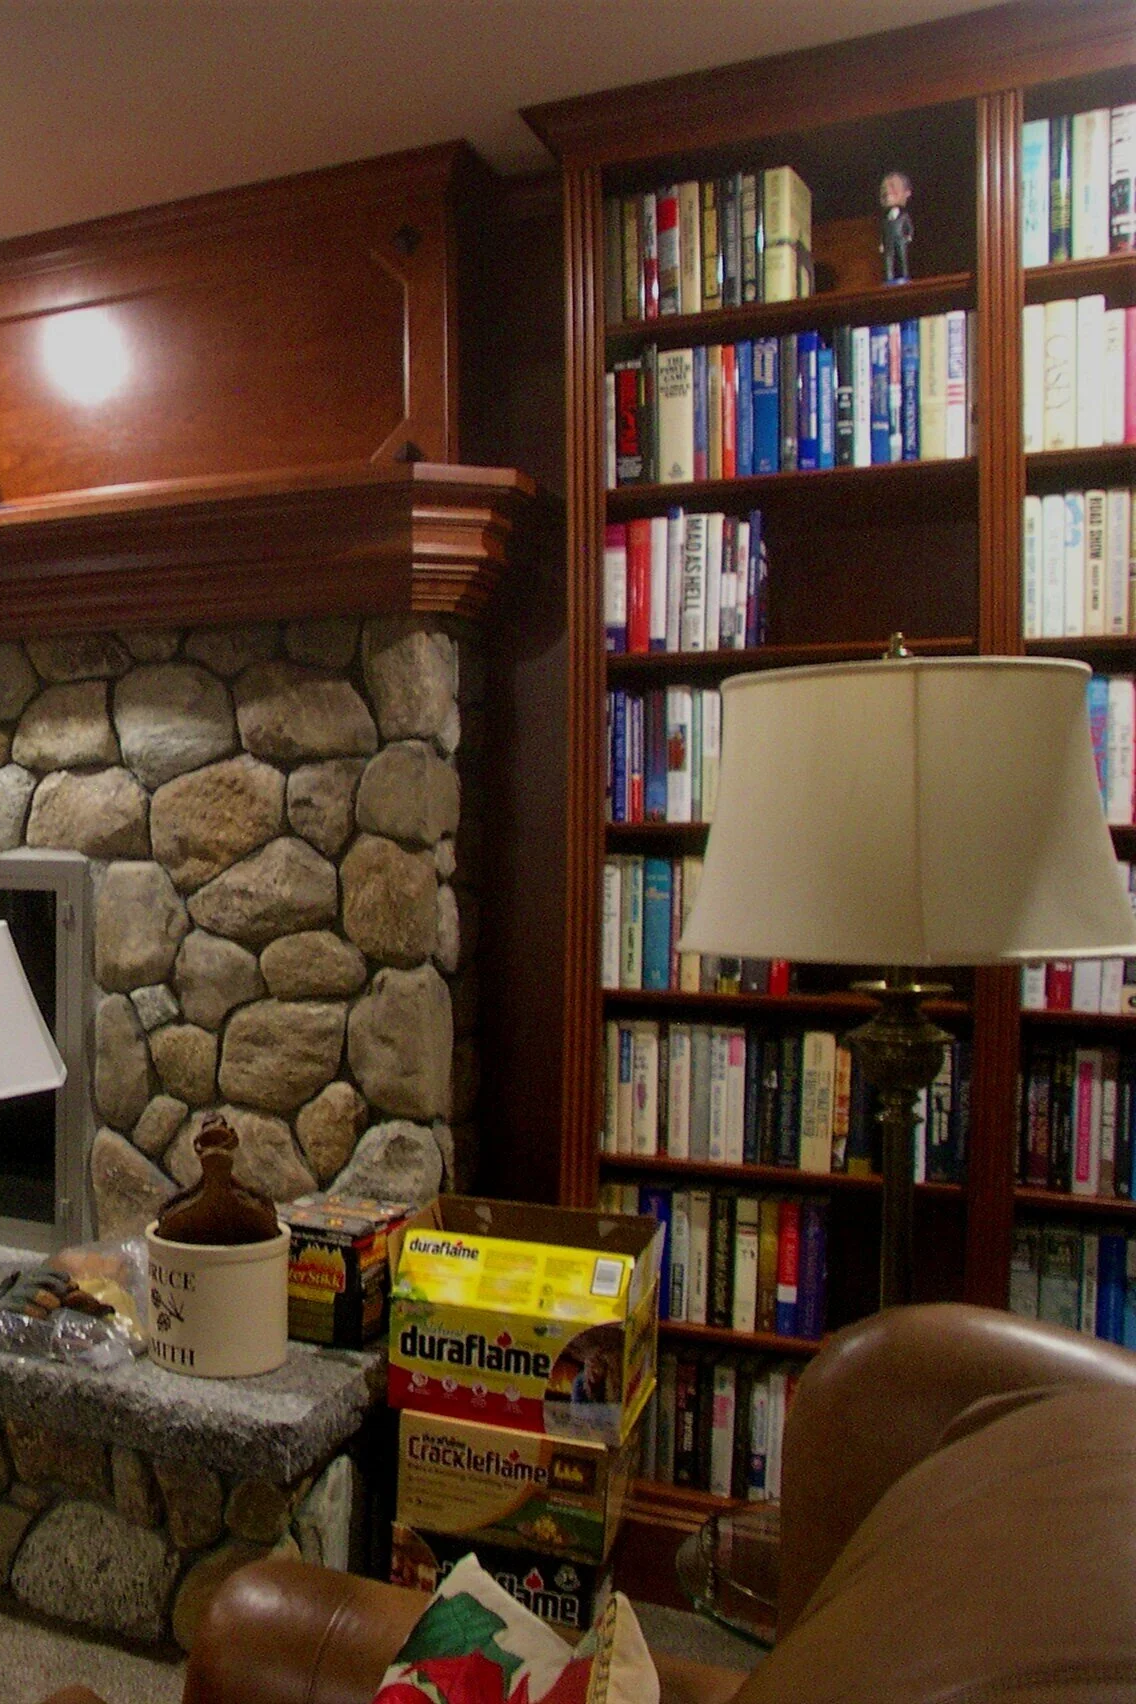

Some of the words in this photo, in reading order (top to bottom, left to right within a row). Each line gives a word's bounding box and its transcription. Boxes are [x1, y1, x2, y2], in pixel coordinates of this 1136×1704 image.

[659, 365, 691, 374] POWER
[667, 356, 684, 365] THE
[1044, 334, 1072, 411] CASEY
[1089, 496, 1103, 526] ROAD
[684, 518, 703, 552] MAD
[1090, 529, 1103, 560] SHOW
[684, 555, 702, 573] AS
[684, 576, 700, 612] HELL
[409, 1237, 480, 1260] duraflame
[148, 1261, 196, 1292] RUCE
[151, 1337, 196, 1367] MITH
[399, 1325, 551, 1379] duraflame
[408, 1436, 548, 1483] Crackleflame
